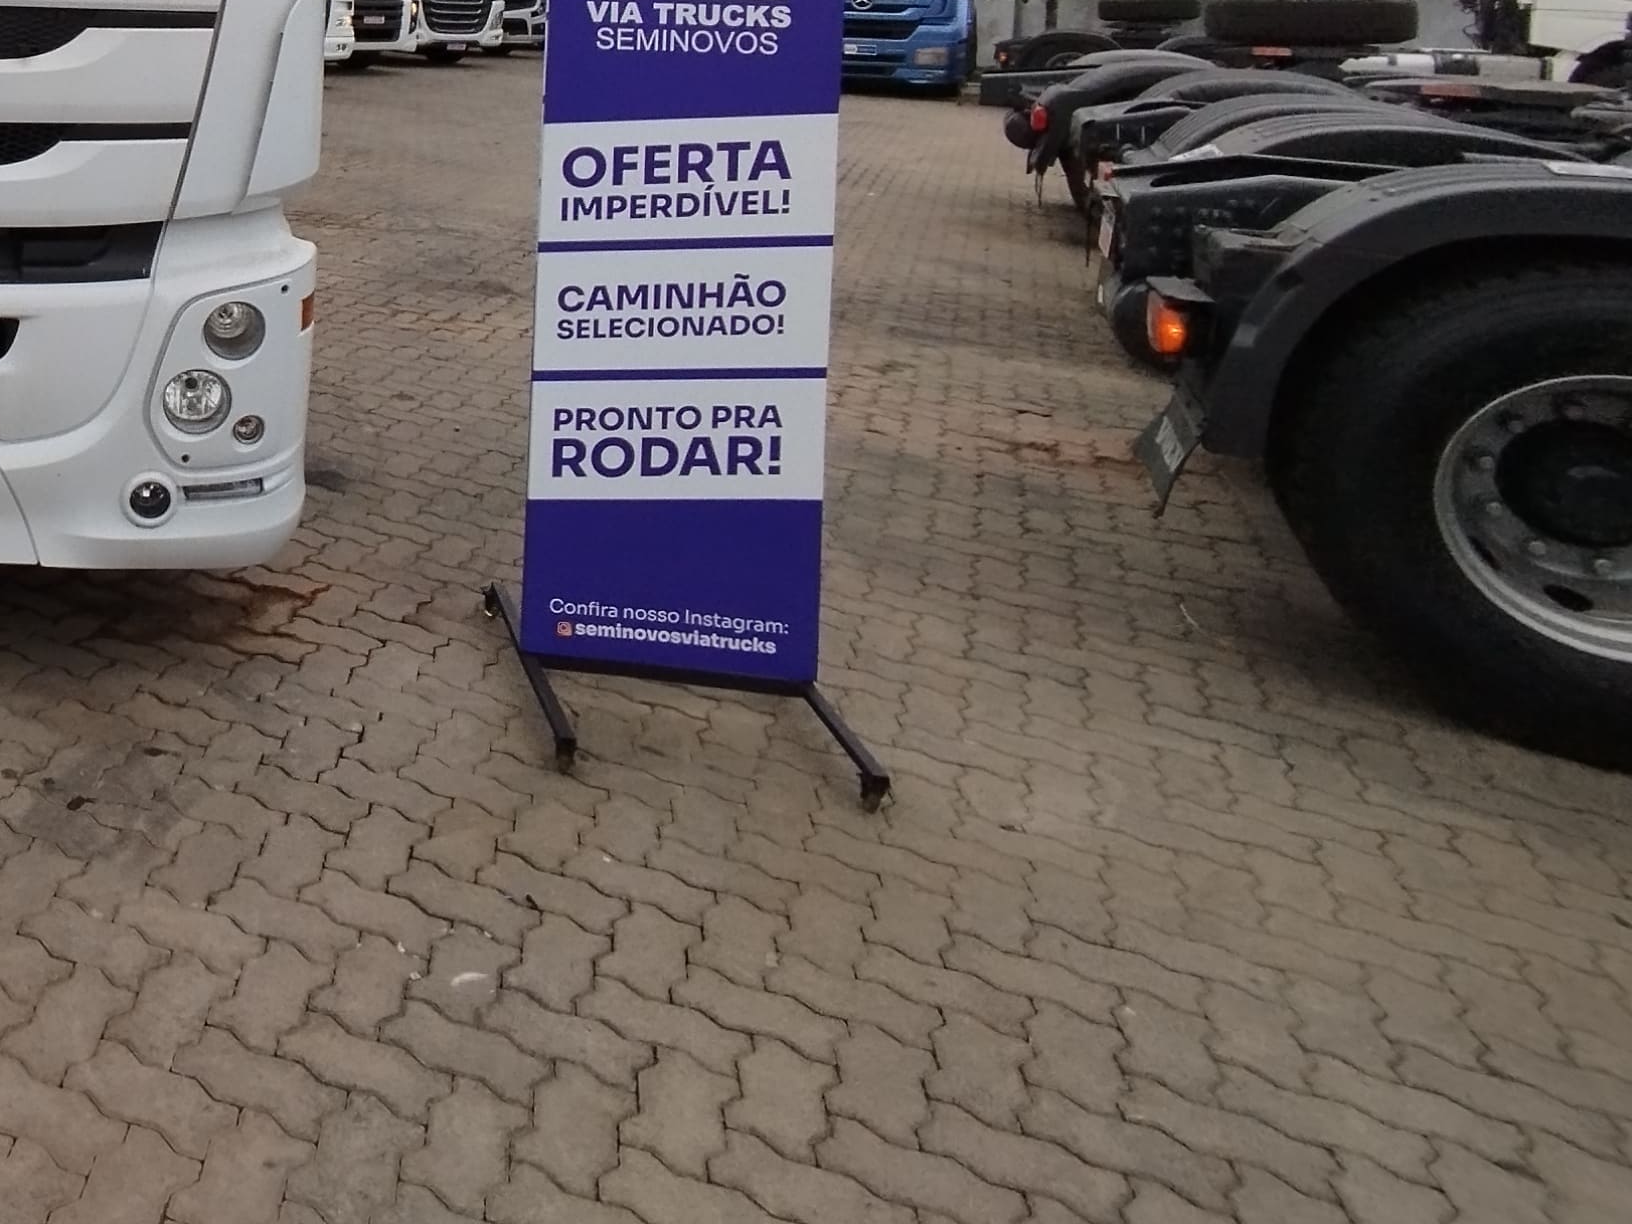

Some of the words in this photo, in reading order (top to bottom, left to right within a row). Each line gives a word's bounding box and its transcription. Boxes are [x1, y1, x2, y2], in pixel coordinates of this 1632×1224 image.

[586, 1, 643, 24] VIA
[653, 2, 792, 28] TRUCKS
[596, 27, 778, 55] SEMINOVOS
[562, 140, 792, 188] OFERTA
[561, 184, 790, 221] IMPERDÍVEL!
[557, 273, 787, 312] CAMINHÃO
[557, 314, 785, 339] SELECIONADO!
[553, 406, 702, 431] PRONTO
[711, 405, 783, 428] PRA
[552, 435, 782, 478] RODAR!
[549, 598, 618, 618] Confira
[623, 607, 680, 624] nosso
[685, 609, 789, 635] Instagram:
[574, 622, 777, 655] seminovosviatrucks
